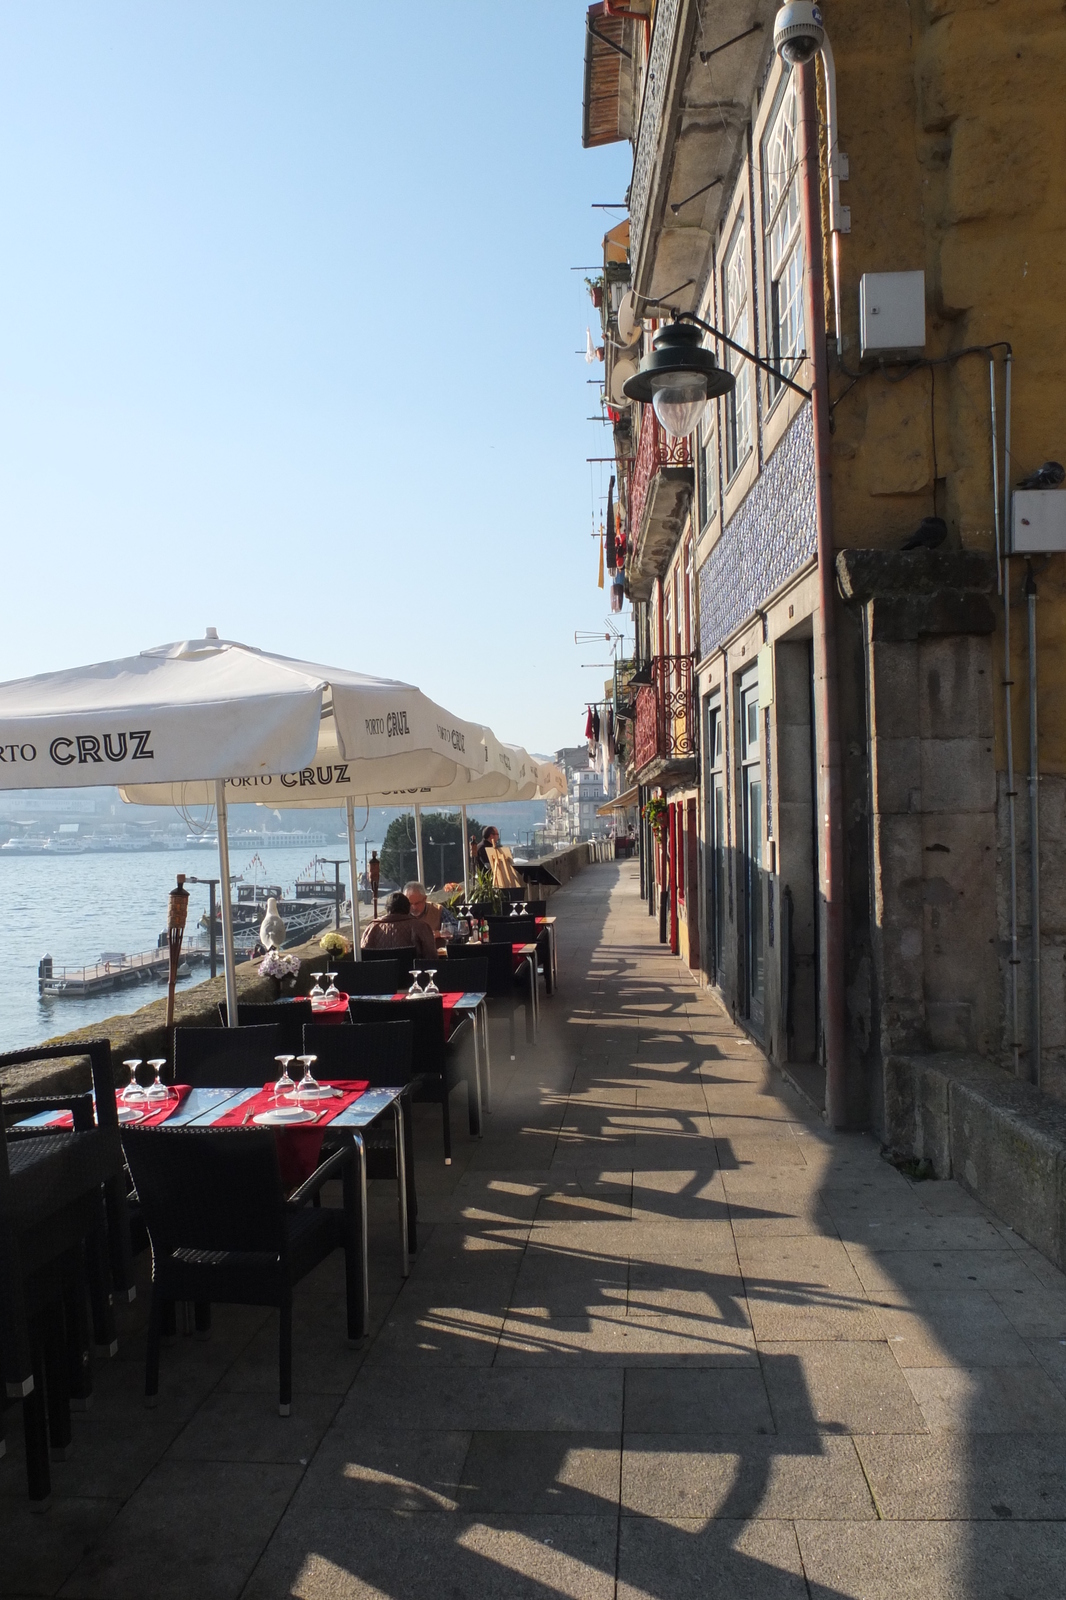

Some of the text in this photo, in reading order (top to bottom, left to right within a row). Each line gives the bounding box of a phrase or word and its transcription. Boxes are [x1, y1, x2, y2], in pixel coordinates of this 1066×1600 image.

[365, 710, 410, 737] PORTO CRUZ
[49, 730, 155, 766] CRUZ
[451, 729, 465, 754] CRUZ
[223, 764, 351, 788] PORTO CRUZ
